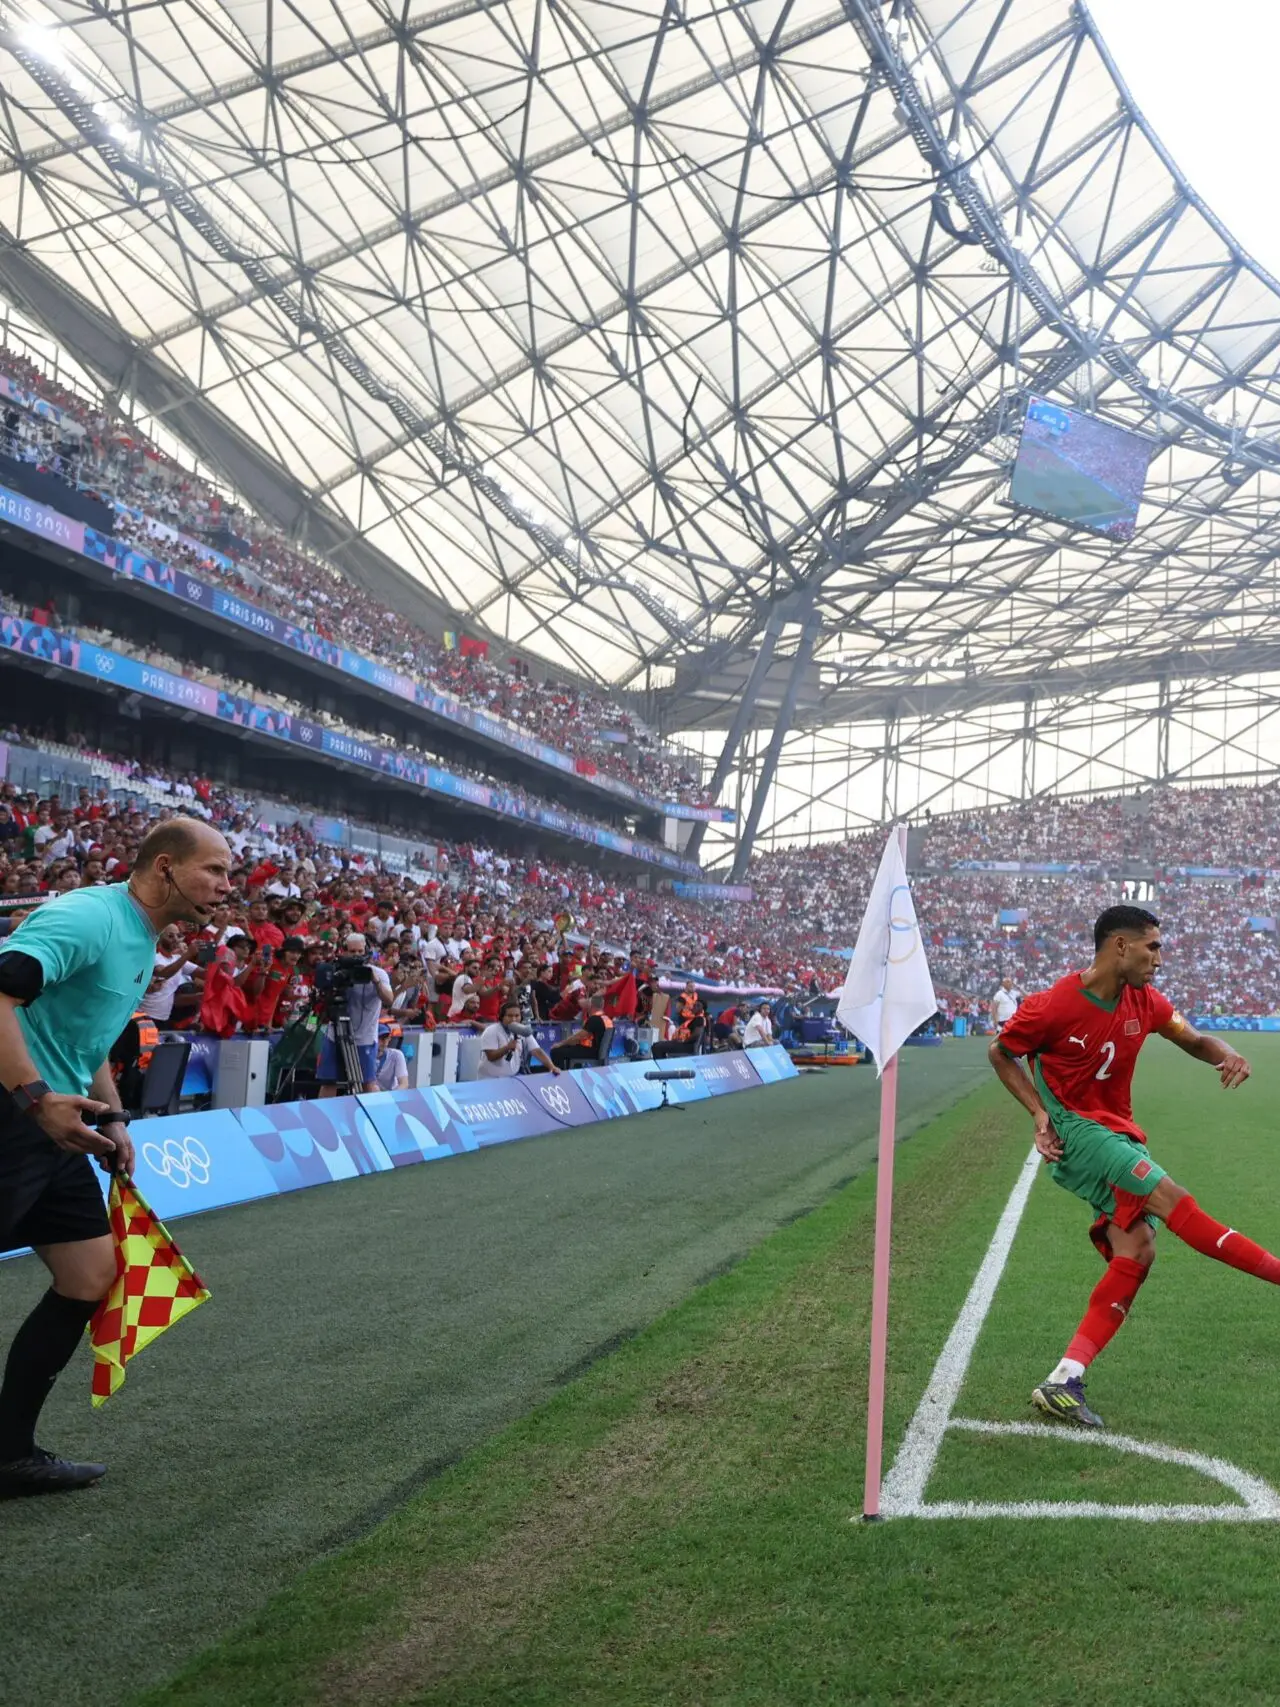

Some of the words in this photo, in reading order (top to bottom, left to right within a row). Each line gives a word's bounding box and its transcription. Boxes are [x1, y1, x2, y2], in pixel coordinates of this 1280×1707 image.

[36, 511, 71, 540] 2024
[222, 599, 250, 622] PARIS
[141, 671, 175, 696] PARIS
[177, 684, 207, 706] 2024
[329, 736, 352, 756] PARIS
[1095, 1041, 1116, 1080] 2
[463, 1102, 501, 1122] PARIS
[496, 1098, 529, 1117] 2024
